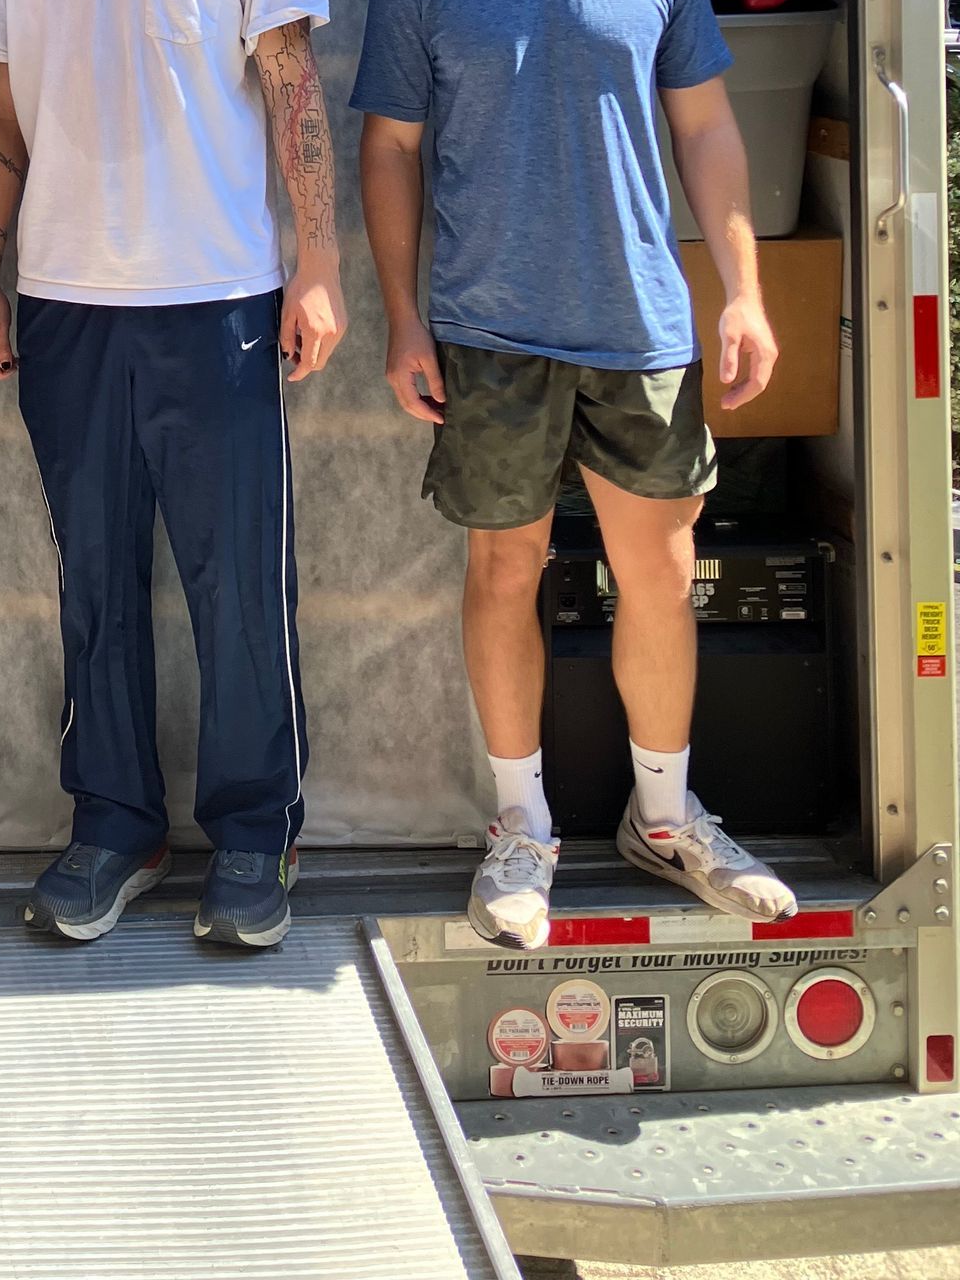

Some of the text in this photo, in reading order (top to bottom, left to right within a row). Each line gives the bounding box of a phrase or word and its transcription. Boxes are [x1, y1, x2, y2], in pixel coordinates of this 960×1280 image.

[618, 1010, 663, 1019] MAXIMUM
[618, 1018, 663, 1028] SECURITY
[542, 1075, 610, 1086] TIE-DOWN ROPE
